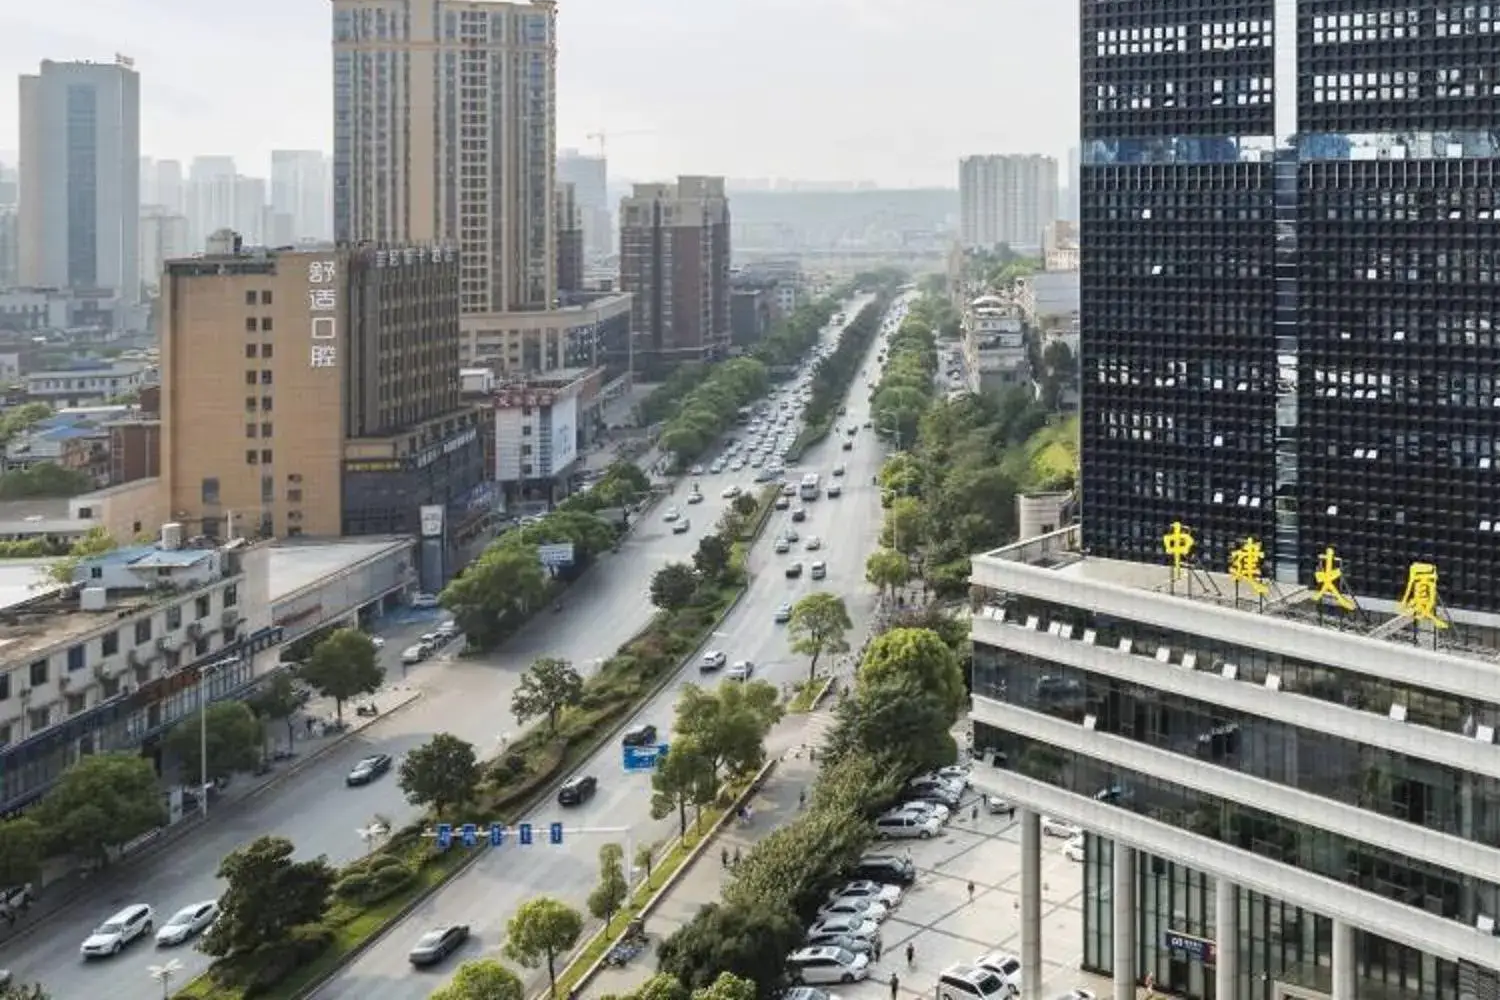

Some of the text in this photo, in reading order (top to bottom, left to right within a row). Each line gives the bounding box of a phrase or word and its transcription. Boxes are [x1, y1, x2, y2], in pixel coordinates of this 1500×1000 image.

[308, 261, 336, 367] 舒适口腔
[1163, 521, 1449, 628] 中建大厦
